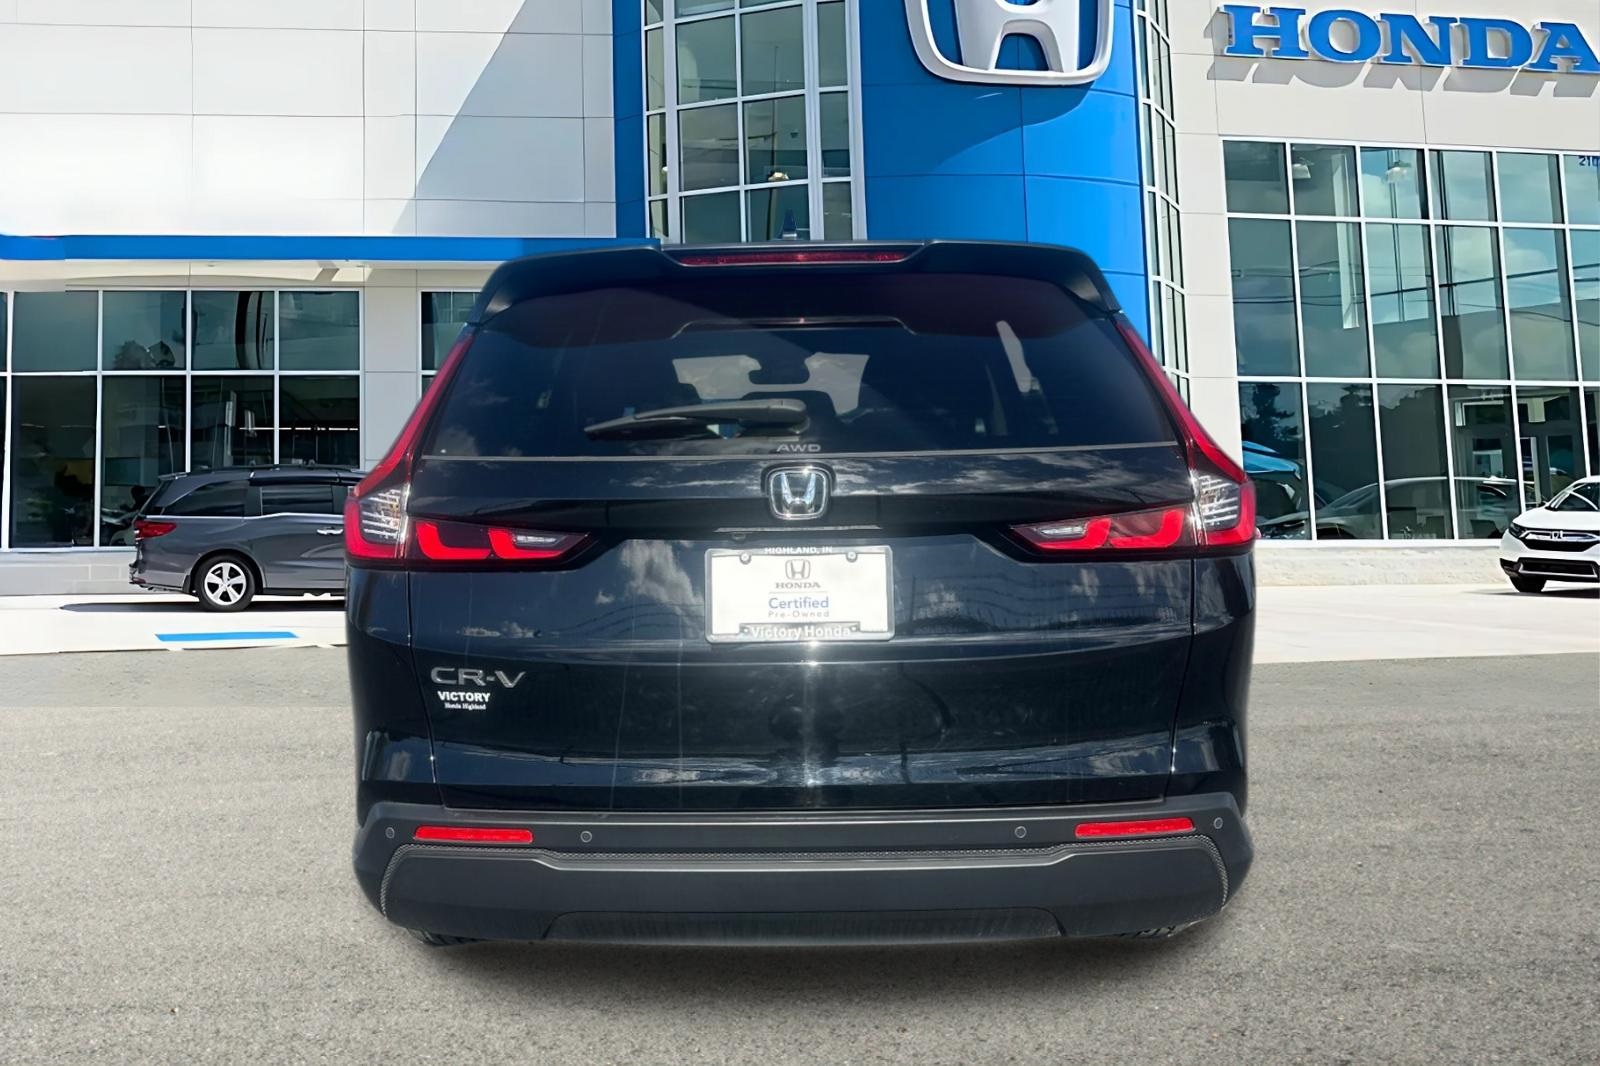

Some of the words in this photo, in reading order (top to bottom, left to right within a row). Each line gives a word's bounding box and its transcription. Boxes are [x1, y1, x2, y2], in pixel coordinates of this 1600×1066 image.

[1222, 4, 1600, 73] HONDA
[776, 443, 821, 453] AWD
[764, 546, 820, 555] HIGHLAND,
[821, 545, 833, 554] IN
[775, 581, 821, 590] HONDA
[768, 595, 829, 609] Certified
[767, 609, 830, 619] Pre-Owned
[751, 626, 801, 641] Victory
[804, 625, 850, 638] Honda
[430, 666, 526, 689] CR-V
[437, 690, 491, 703] VICTORY
